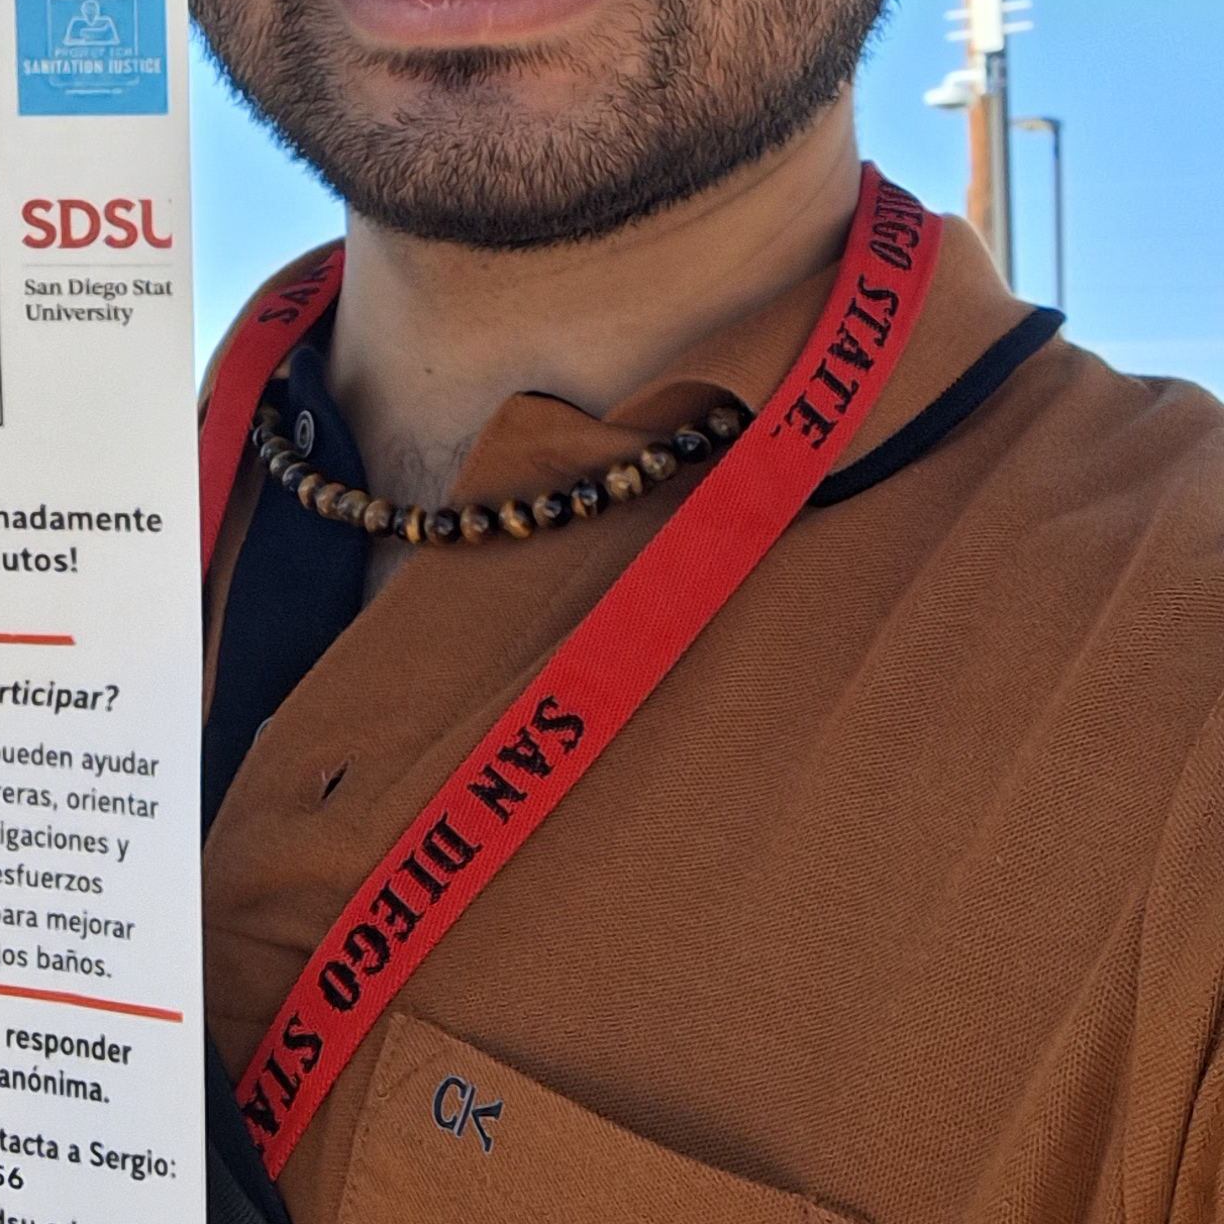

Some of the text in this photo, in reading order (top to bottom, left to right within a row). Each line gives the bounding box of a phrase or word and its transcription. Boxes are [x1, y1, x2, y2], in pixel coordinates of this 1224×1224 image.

[24, 278, 173, 301] San Diego Stat
[25, 302, 135, 327] University
[784, 273, 900, 450] STATE
[81, 750, 160, 778] ayudar
[66, 787, 160, 820] orientar
[116, 838, 130, 864] y
[46, 910, 136, 941] mejorar
[244, 694, 585, 1153] SAN DIEGO STA
[36, 944, 112, 979] baños.
[5, 1028, 133, 1066] responder
[67, 1143, 82, 1164] a
[89, 1140, 177, 1182] Sergio:
